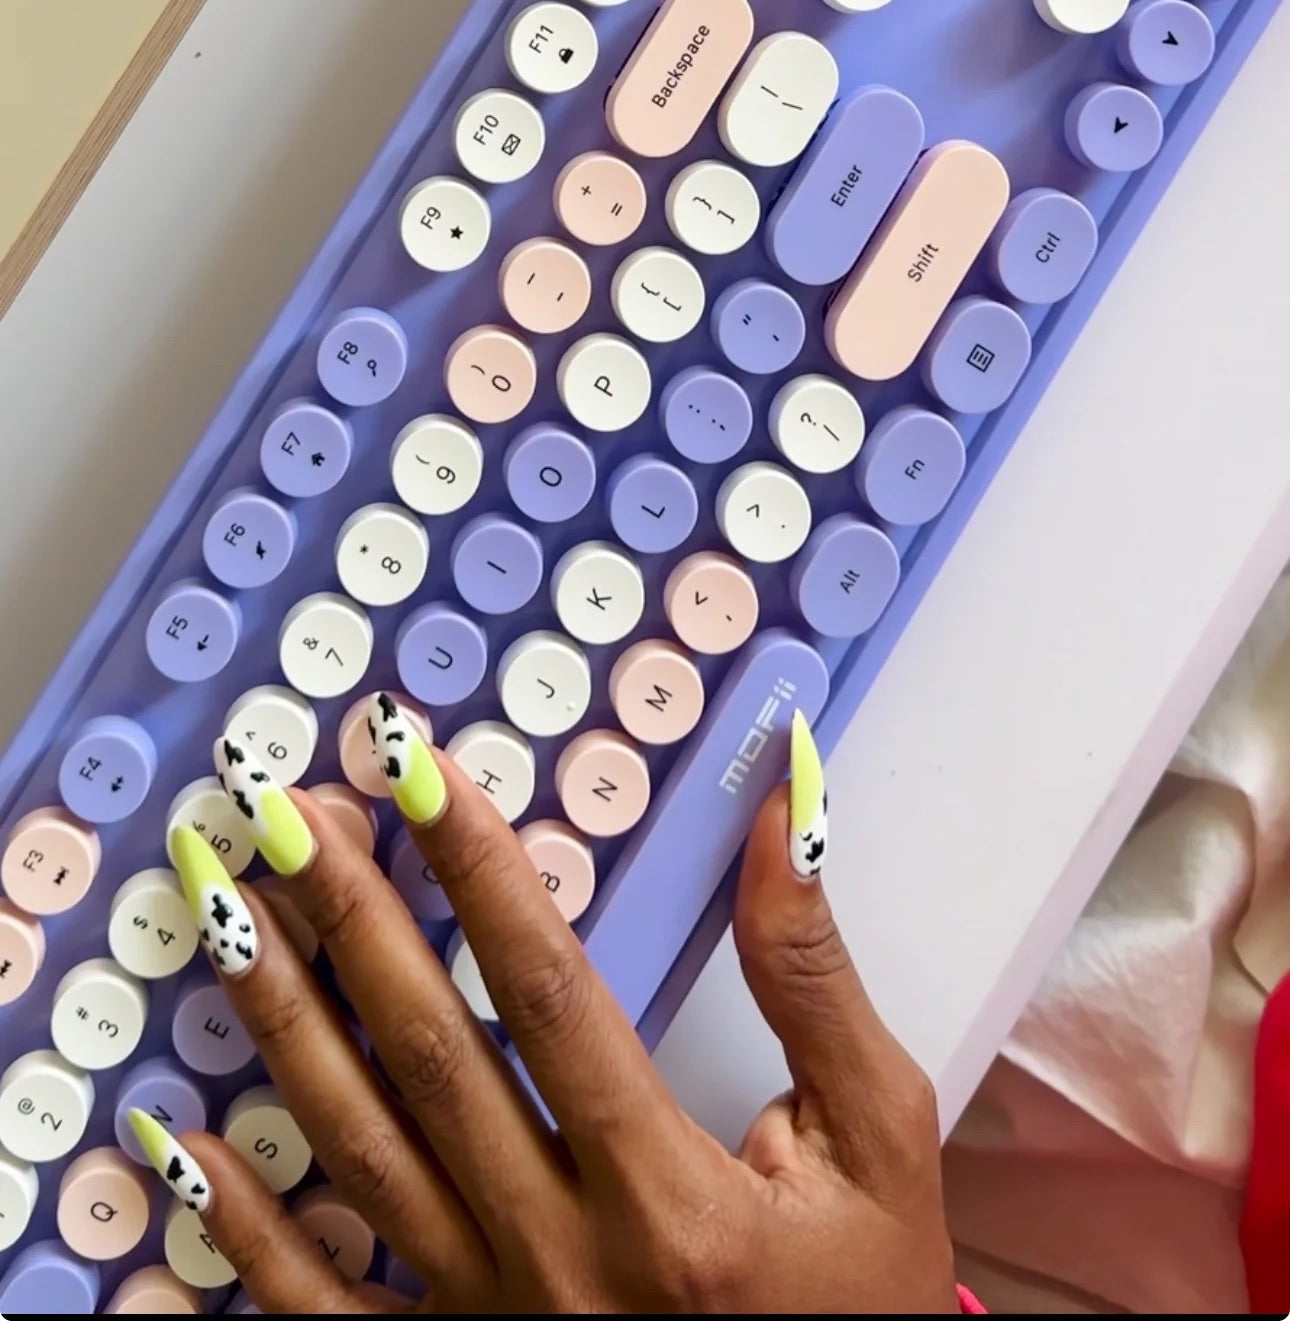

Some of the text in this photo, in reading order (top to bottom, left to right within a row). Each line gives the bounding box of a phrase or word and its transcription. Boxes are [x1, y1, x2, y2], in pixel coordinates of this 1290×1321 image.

[528, 25, 554, 54] F11
[651, 25, 710, 108] Backspace
[472, 114, 499, 146] F10
[830, 164, 862, 207] Enter
[419, 206, 442, 230] F9
[1035, 232, 1061, 263] Ctrl
[907, 243, 939, 282] Shift
[336, 341, 359, 365] F8
[491, 374, 512, 393] 0
[593, 375, 613, 397] P
[280, 431, 301, 456] F7
[436, 465, 456, 485] 9
[539, 466, 563, 488] O
[904, 459, 925, 480] Fn
[641, 505, 666, 519] L
[223, 523, 246, 546] F6
[381, 556, 402, 575] 8
[839, 569, 861, 595] Alt
[586, 587, 612, 611] K
[165, 615, 189, 640] F5
[324, 647, 344, 667] 7
[428, 646, 454, 670] U
[537, 678, 556, 699] J
[644, 684, 673, 712] M
[267, 742, 288, 760] 6
[79, 756, 102, 781] F4
[475, 769, 503, 794] H
[591, 776, 618, 802] N
[210, 834, 232, 854] 5
[22, 849, 44, 872] F3
[541, 870, 561, 893] B
[157, 928, 176, 946] 4
[97, 1019, 119, 1038] 3
[203, 1017, 230, 1040] E
[40, 1112, 63, 1131] 2
[254, 1137, 278, 1160] S
[90, 1201, 118, 1223] Q
